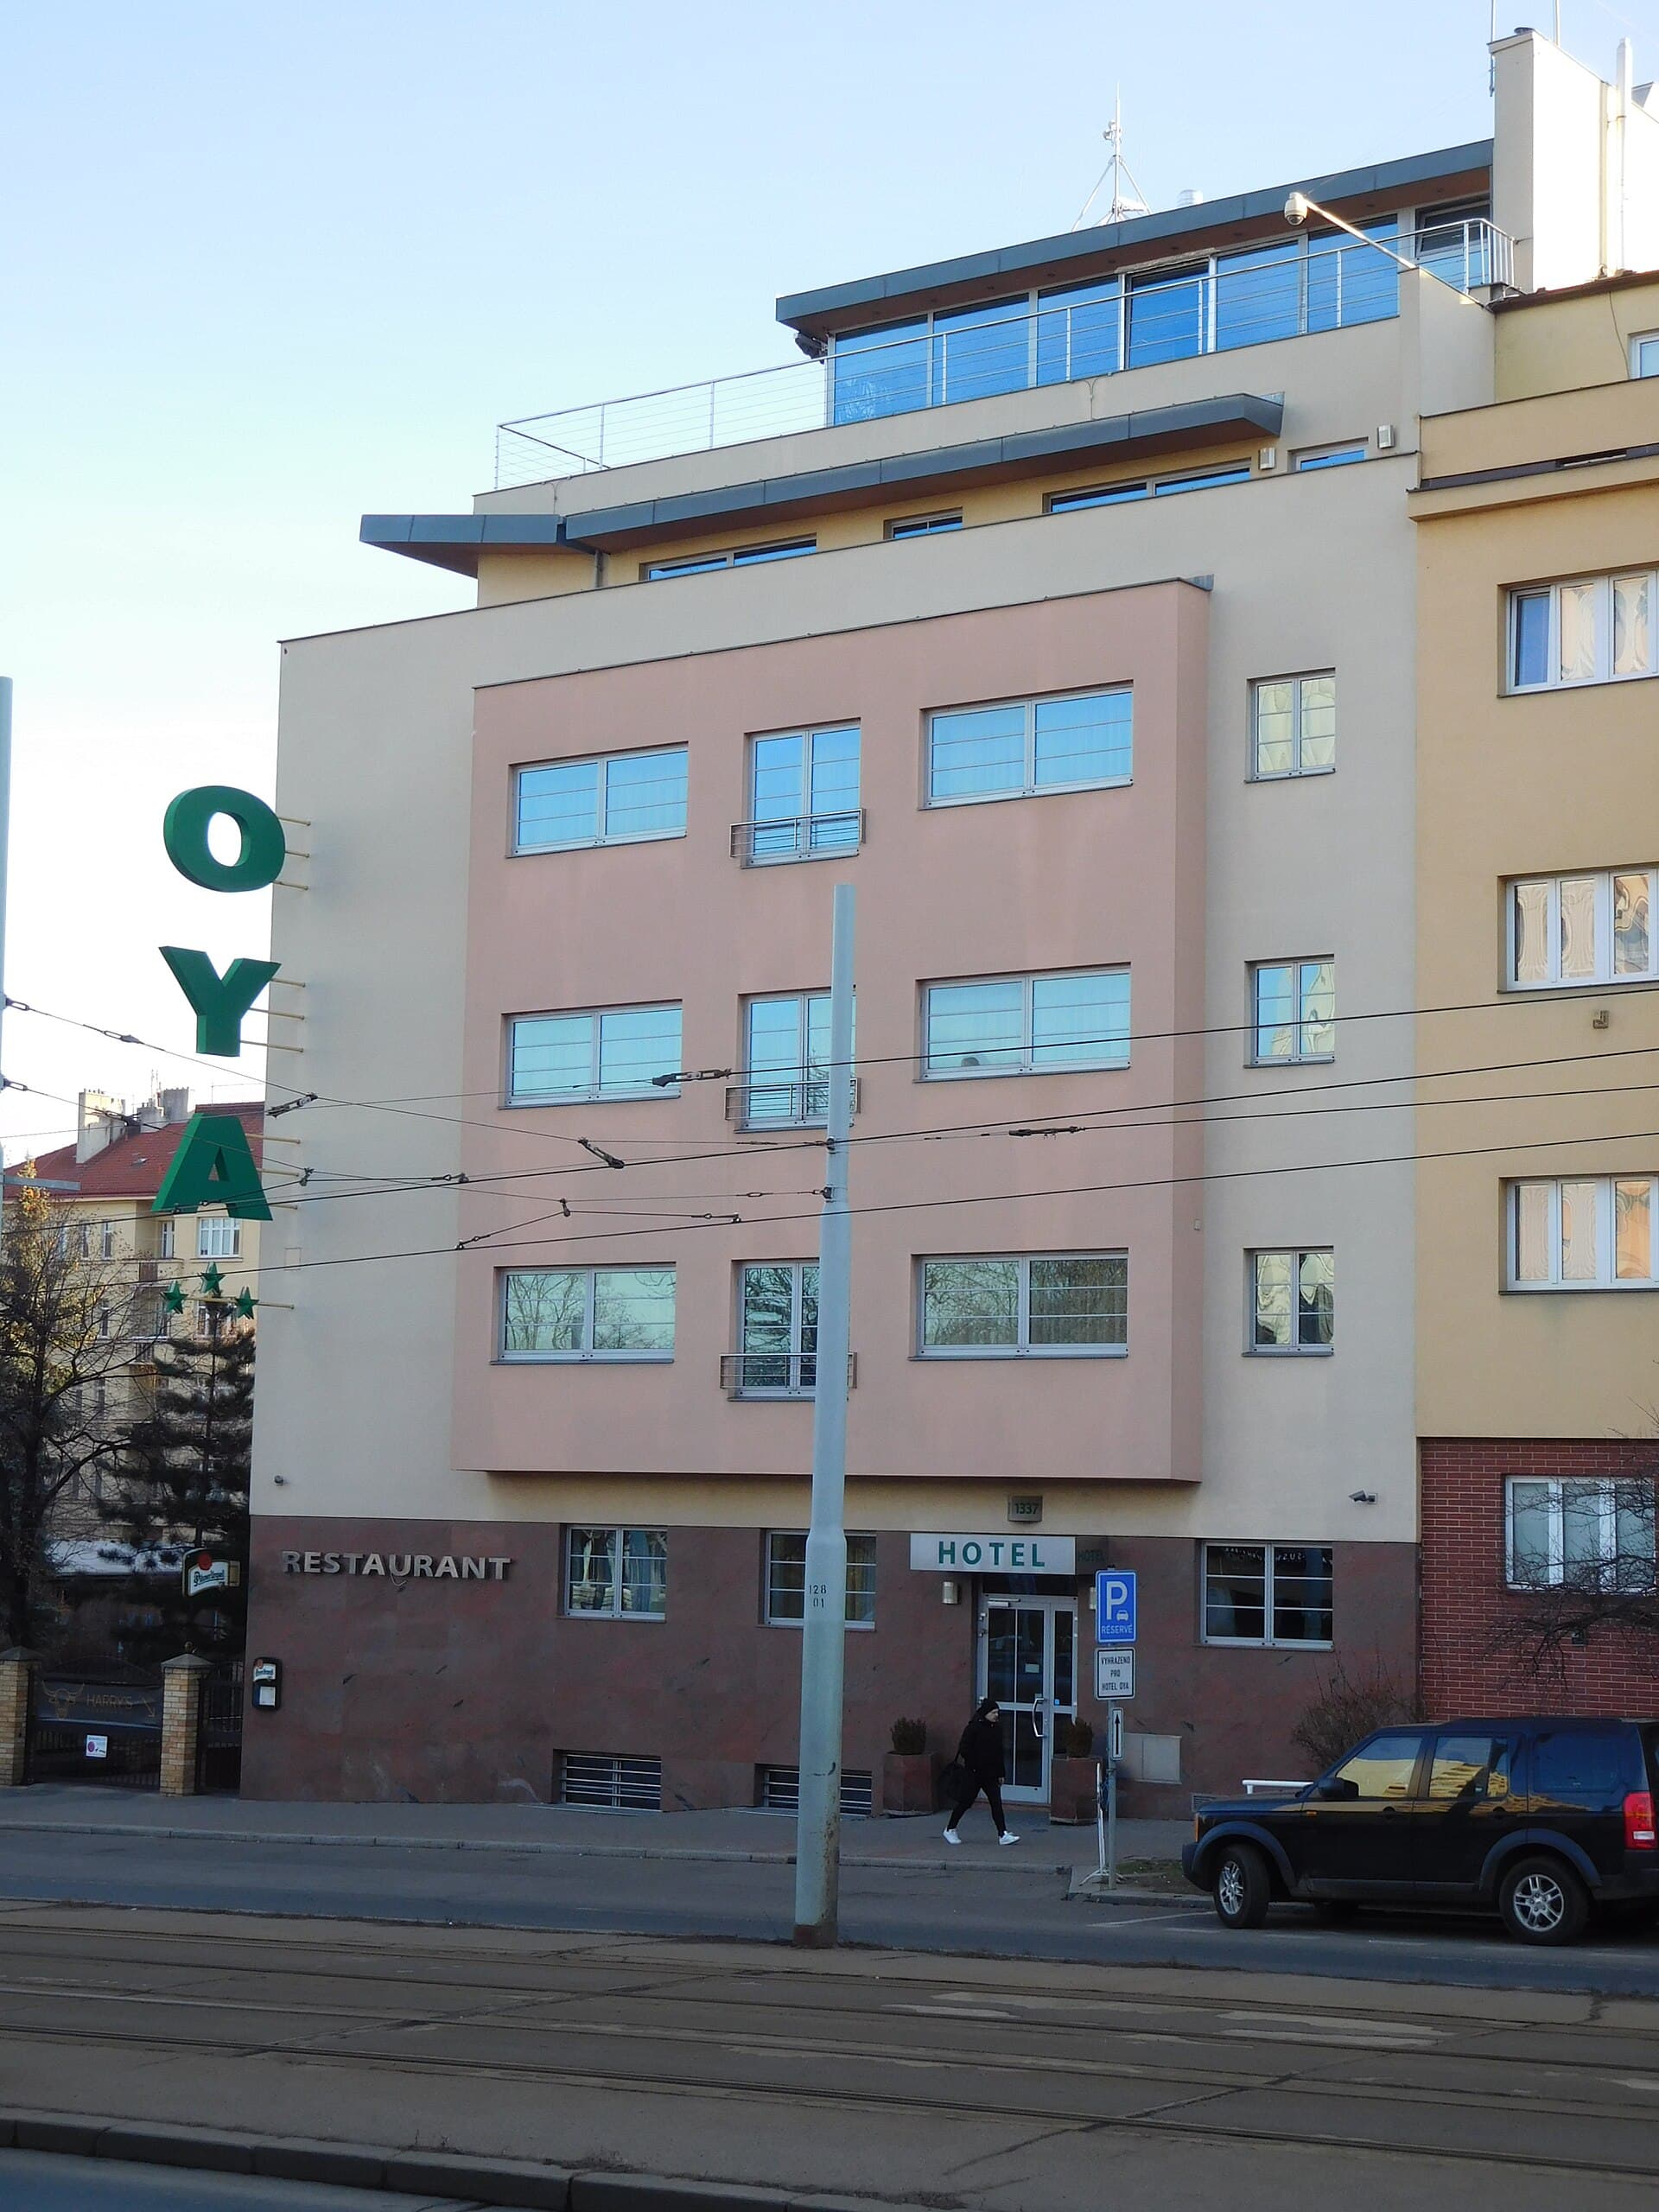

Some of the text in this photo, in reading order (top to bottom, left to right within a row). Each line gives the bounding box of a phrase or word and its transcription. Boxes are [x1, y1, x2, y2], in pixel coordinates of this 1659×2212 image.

[151, 785, 286, 1222] OYA
[1014, 1502, 1039, 1515] 1337
[938, 1541, 1046, 1567] HOTEL
[281, 1550, 512, 1581] RESTAURANT
[810, 1585, 826, 1594] 128
[813, 1598, 824, 1608] 01
[1106, 1580, 1128, 1621] P
[1101, 1656, 1131, 1665] VYHRAZENO
[1110, 1669, 1121, 1678] PRO
[1102, 1682, 1118, 1691] HOTEL
